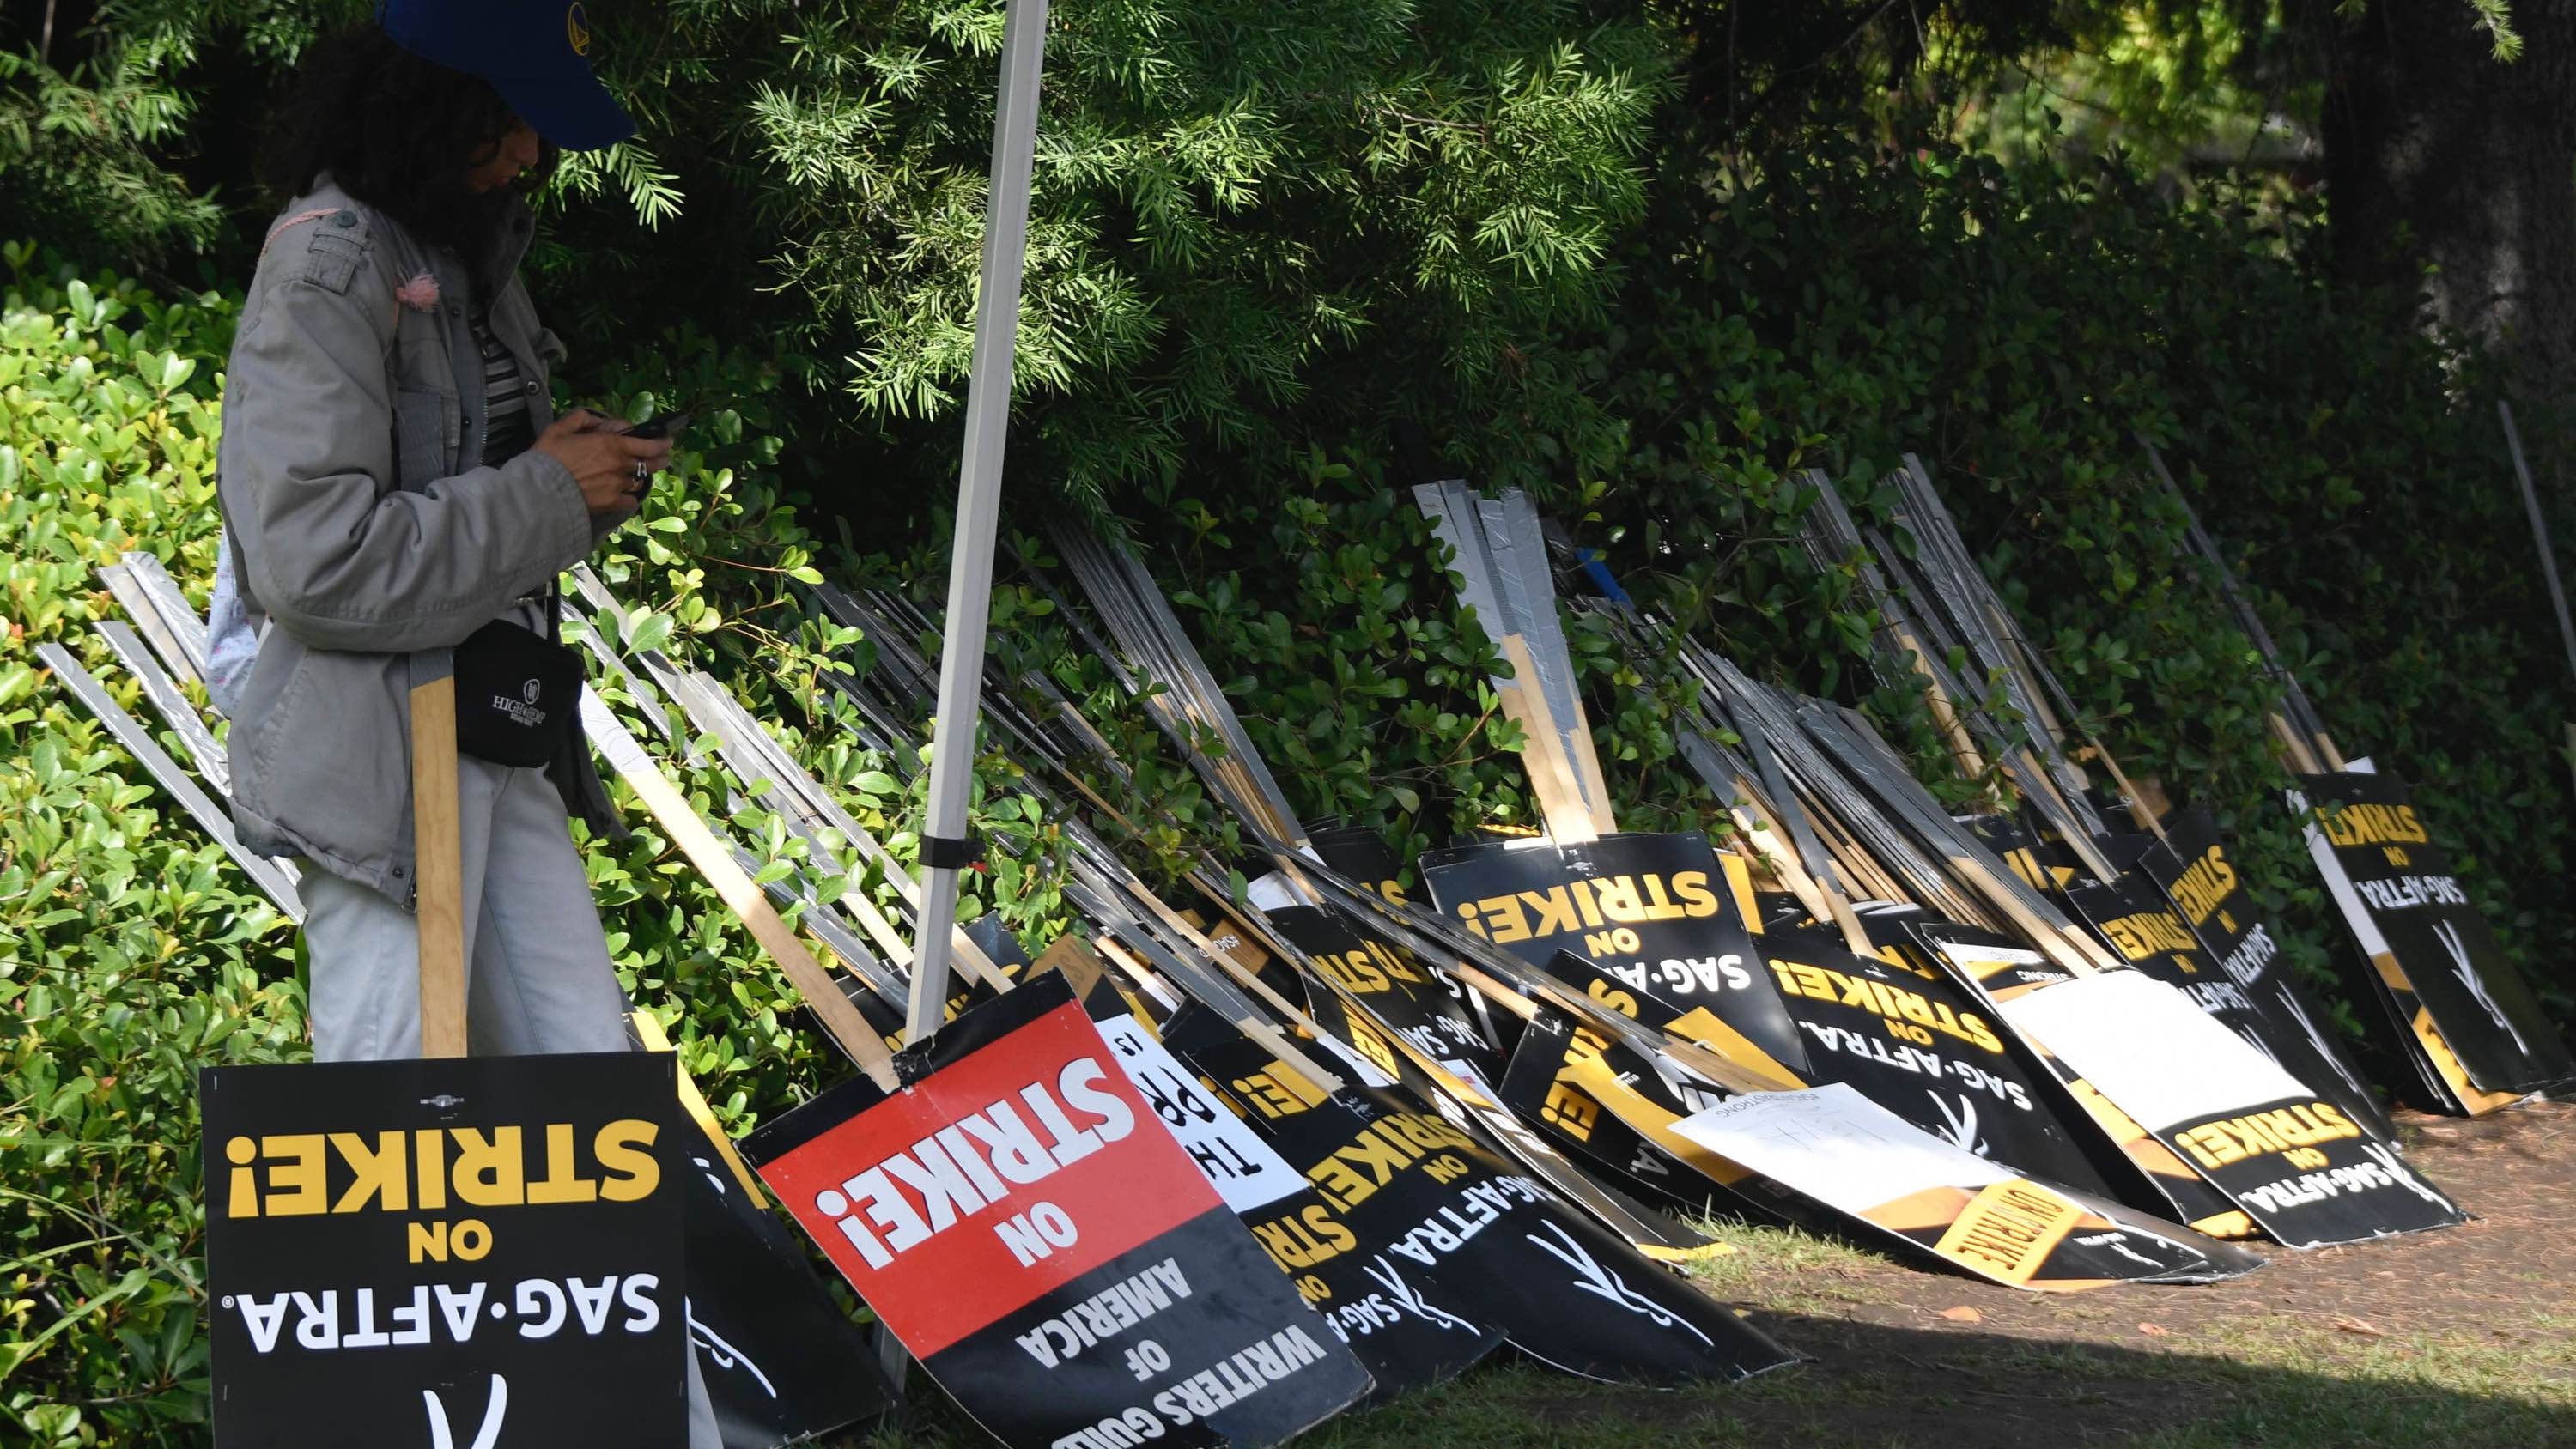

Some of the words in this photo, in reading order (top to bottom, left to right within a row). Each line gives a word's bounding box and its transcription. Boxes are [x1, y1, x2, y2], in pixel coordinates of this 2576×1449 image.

[1457, 871, 1718, 944] STRIKE!
[1584, 928, 1641, 958] ON
[1769, 959, 2004, 1054] STRIKE!
[1884, 1019, 1933, 1046] ON
[226, 1119, 660, 1218] STRIKE!
[817, 1057, 1135, 1270] STRIKE!
[1303, 1113, 1475, 1215] STRIKE!
[1421, 1154, 1469, 1185] ON
[2175, 1102, 2361, 1170] STRIKE!
[2281, 1148, 2329, 1170] ON
[408, 1219, 493, 1264] ON
[993, 1202, 1078, 1268] ON
[1016, 1257, 1192, 1369] AMERICA
[1124, 1340, 1171, 1382] OF
[1153, 1325, 1327, 1426] WRITERS
